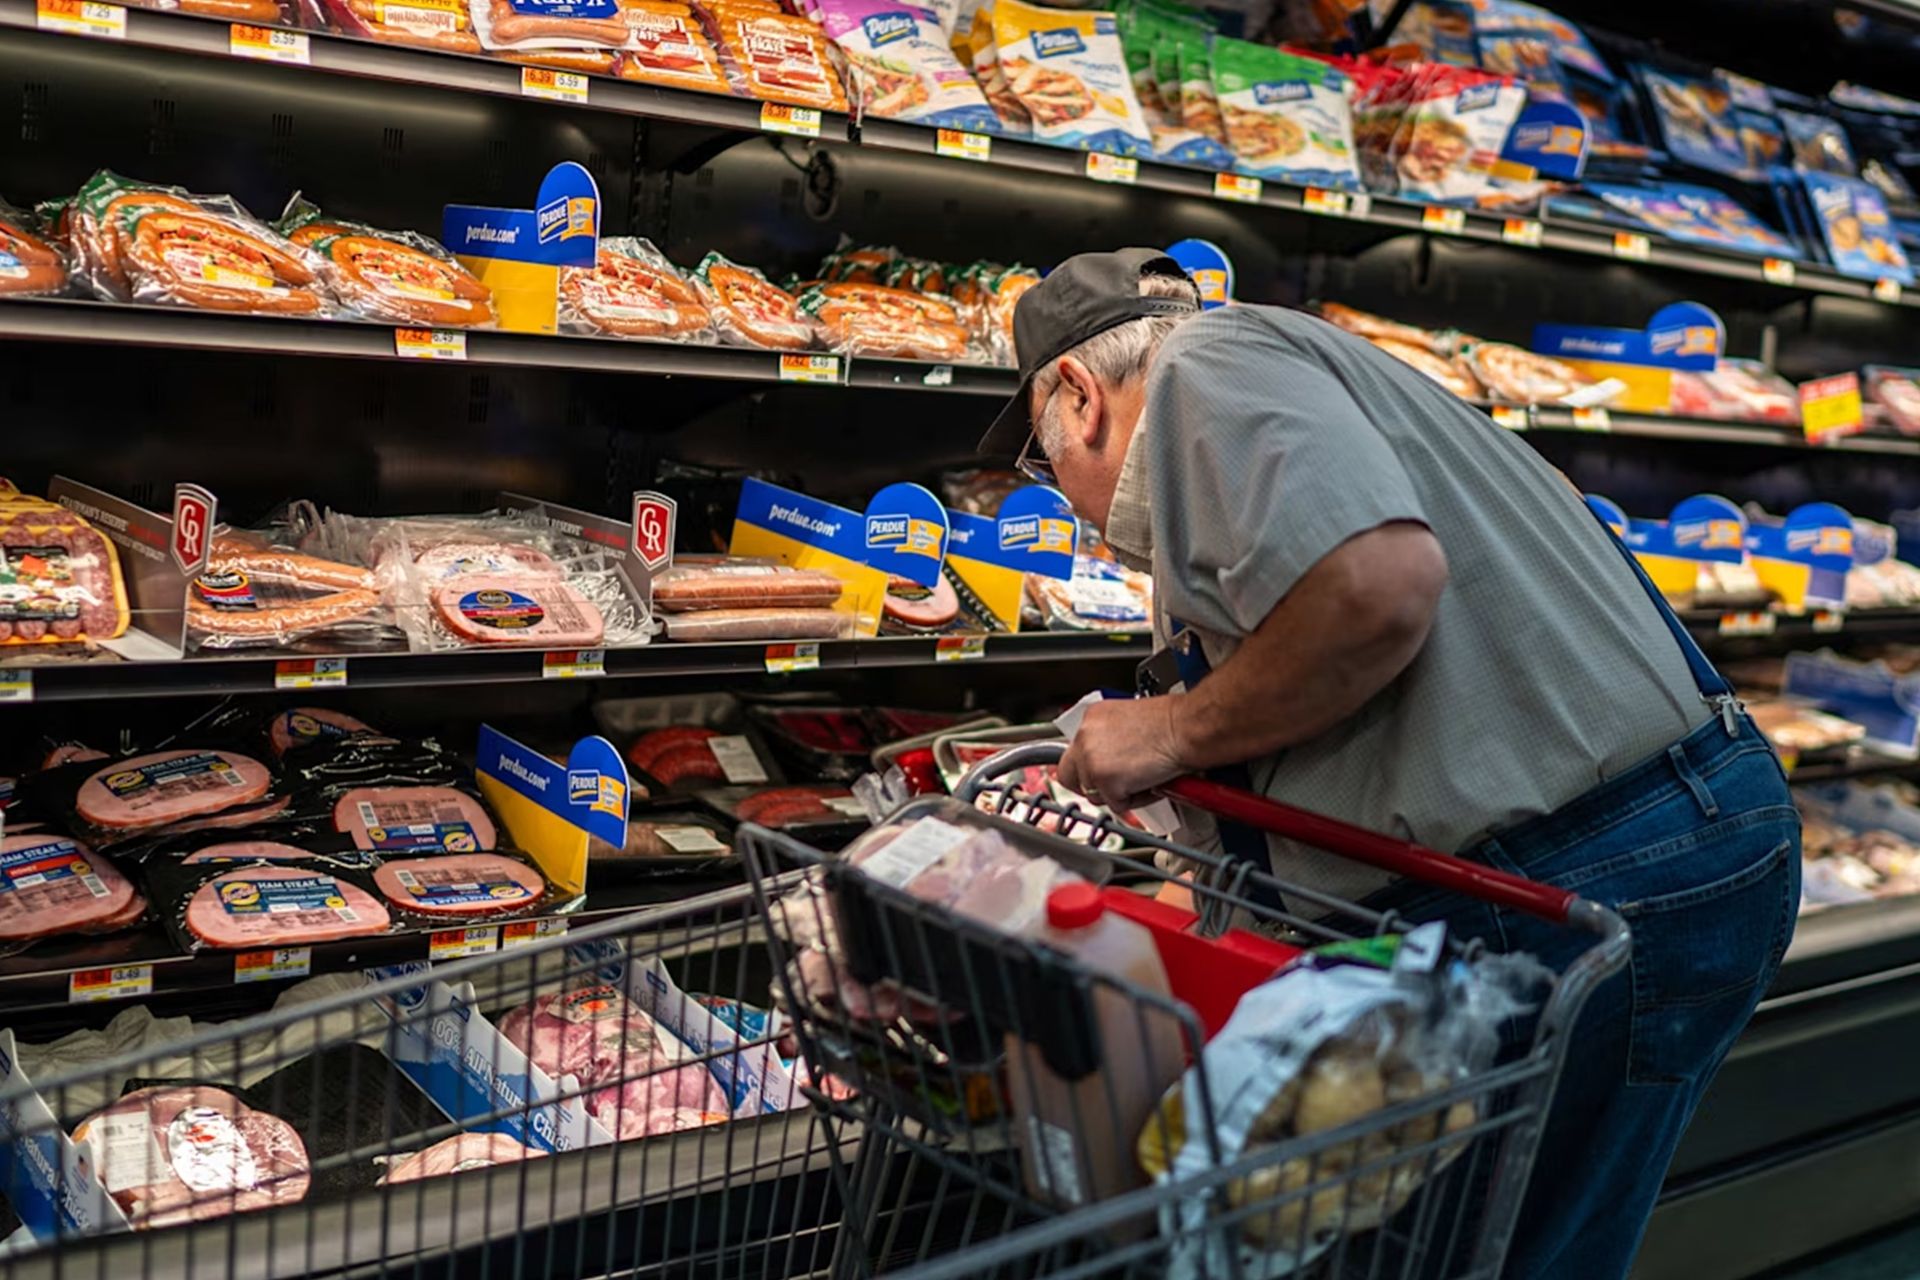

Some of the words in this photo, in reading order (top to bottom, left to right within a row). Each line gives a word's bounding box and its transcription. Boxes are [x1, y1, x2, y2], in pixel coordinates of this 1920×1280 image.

[85, 4, 110, 18] 7.29
[540, 204, 567, 227] PERDUE
[401, 329, 425, 341] 7.42
[869, 520, 906, 534] PERDUE
[1002, 521, 1037, 535] PERDUE
[571, 775, 597, 789] PERDUE
[24, 846, 58, 858] STEAK
[258, 881, 283, 889] HAM
[284, 879, 317, 888] STEAK
